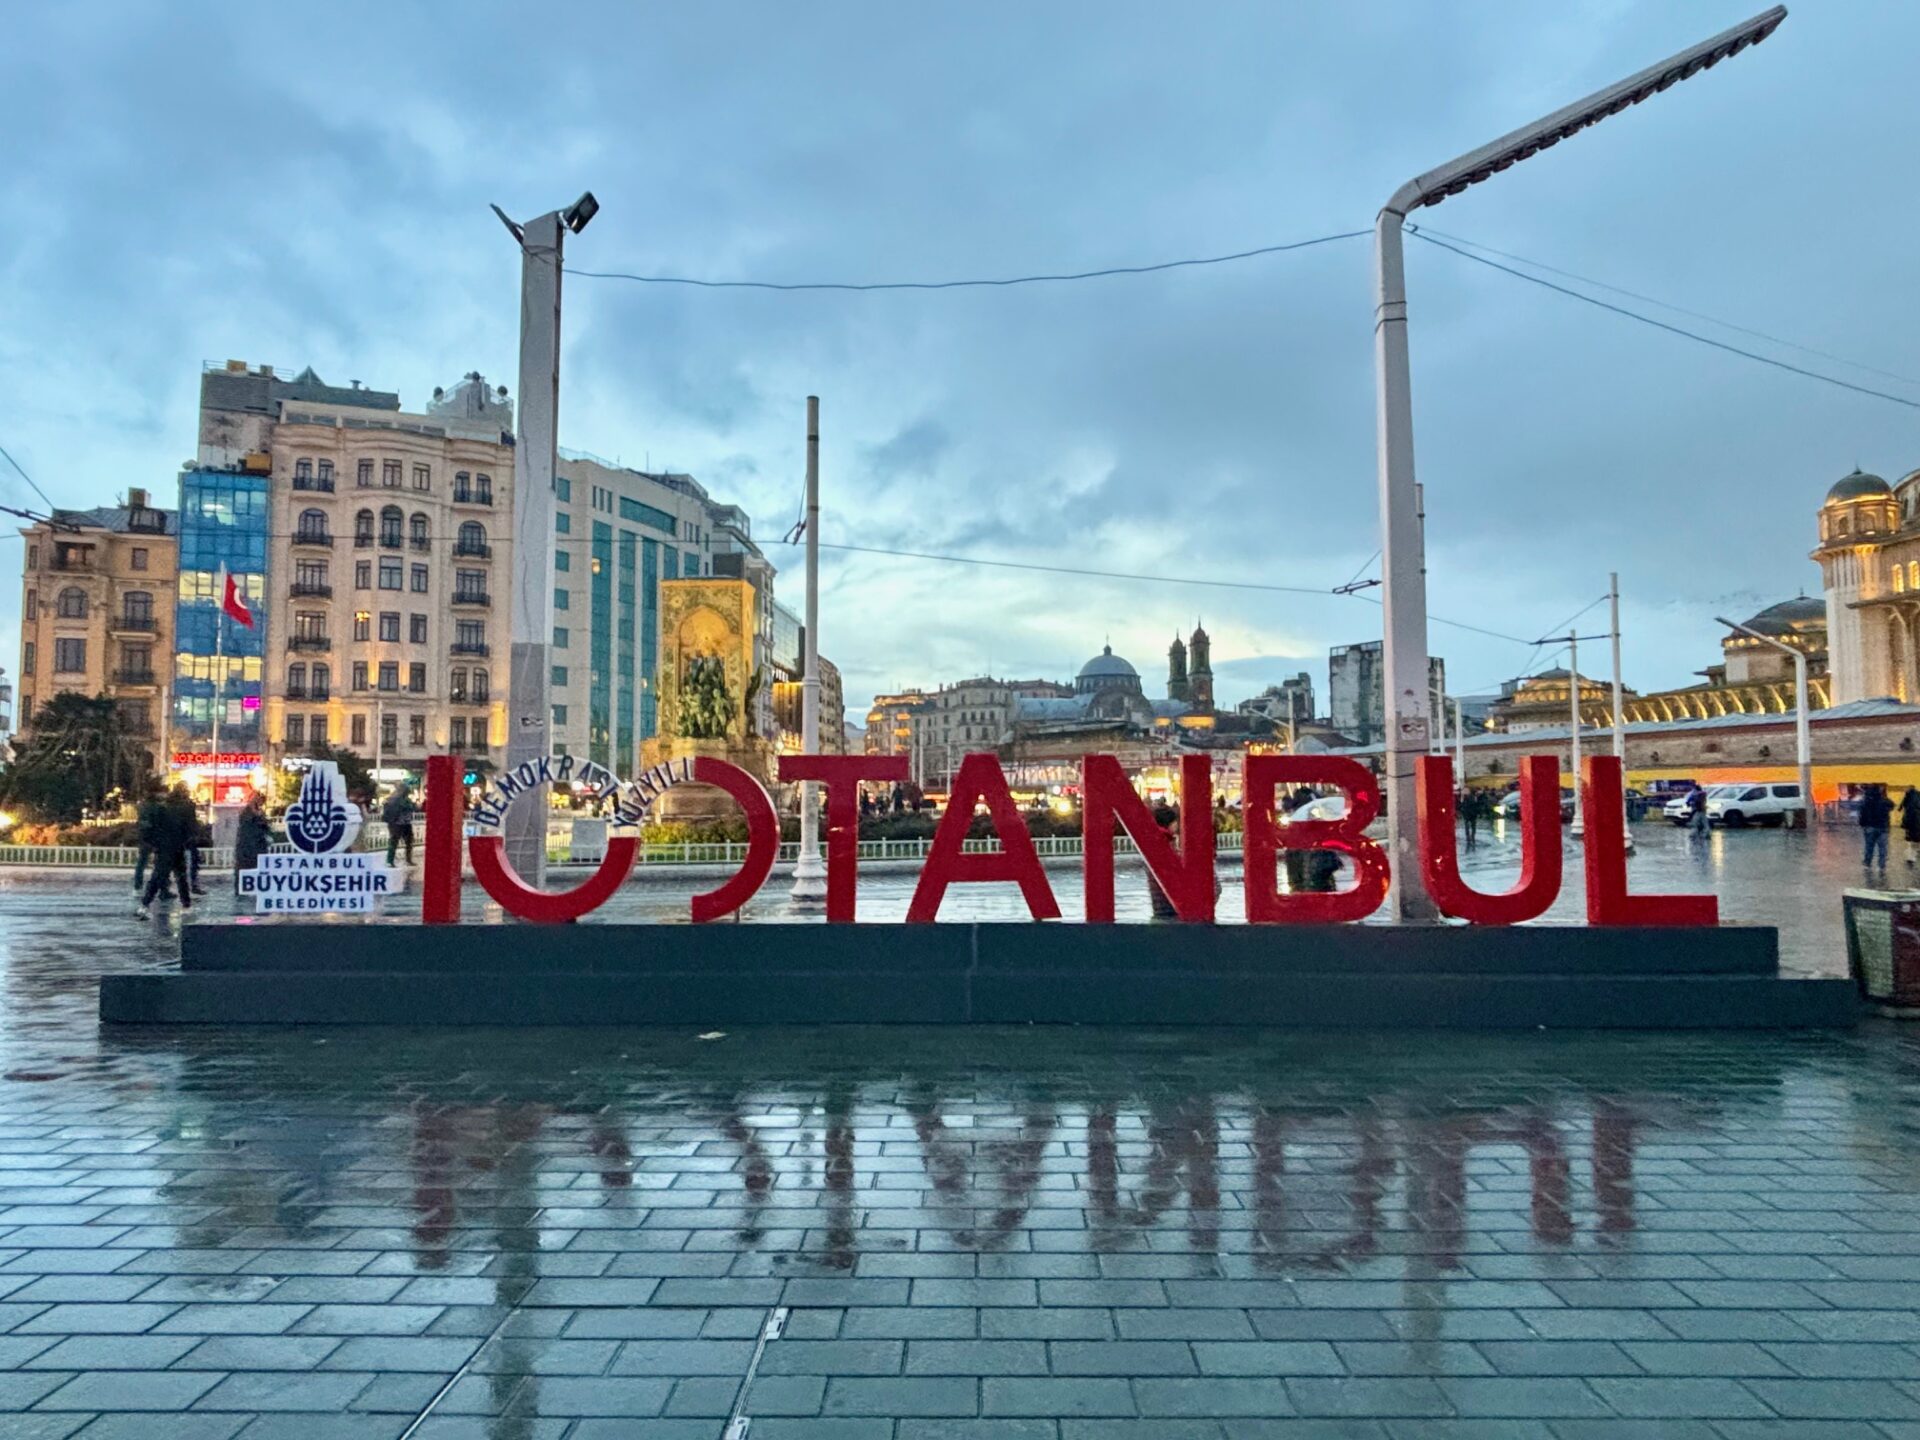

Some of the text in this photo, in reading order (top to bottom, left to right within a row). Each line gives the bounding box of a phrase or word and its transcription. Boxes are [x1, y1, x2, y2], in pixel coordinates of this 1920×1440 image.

[264, 856, 366, 869] İSTANBUL
[242, 870, 388, 894] BÜYÜKŞEHİR
[264, 896, 365, 909] BELEDİYESİ
